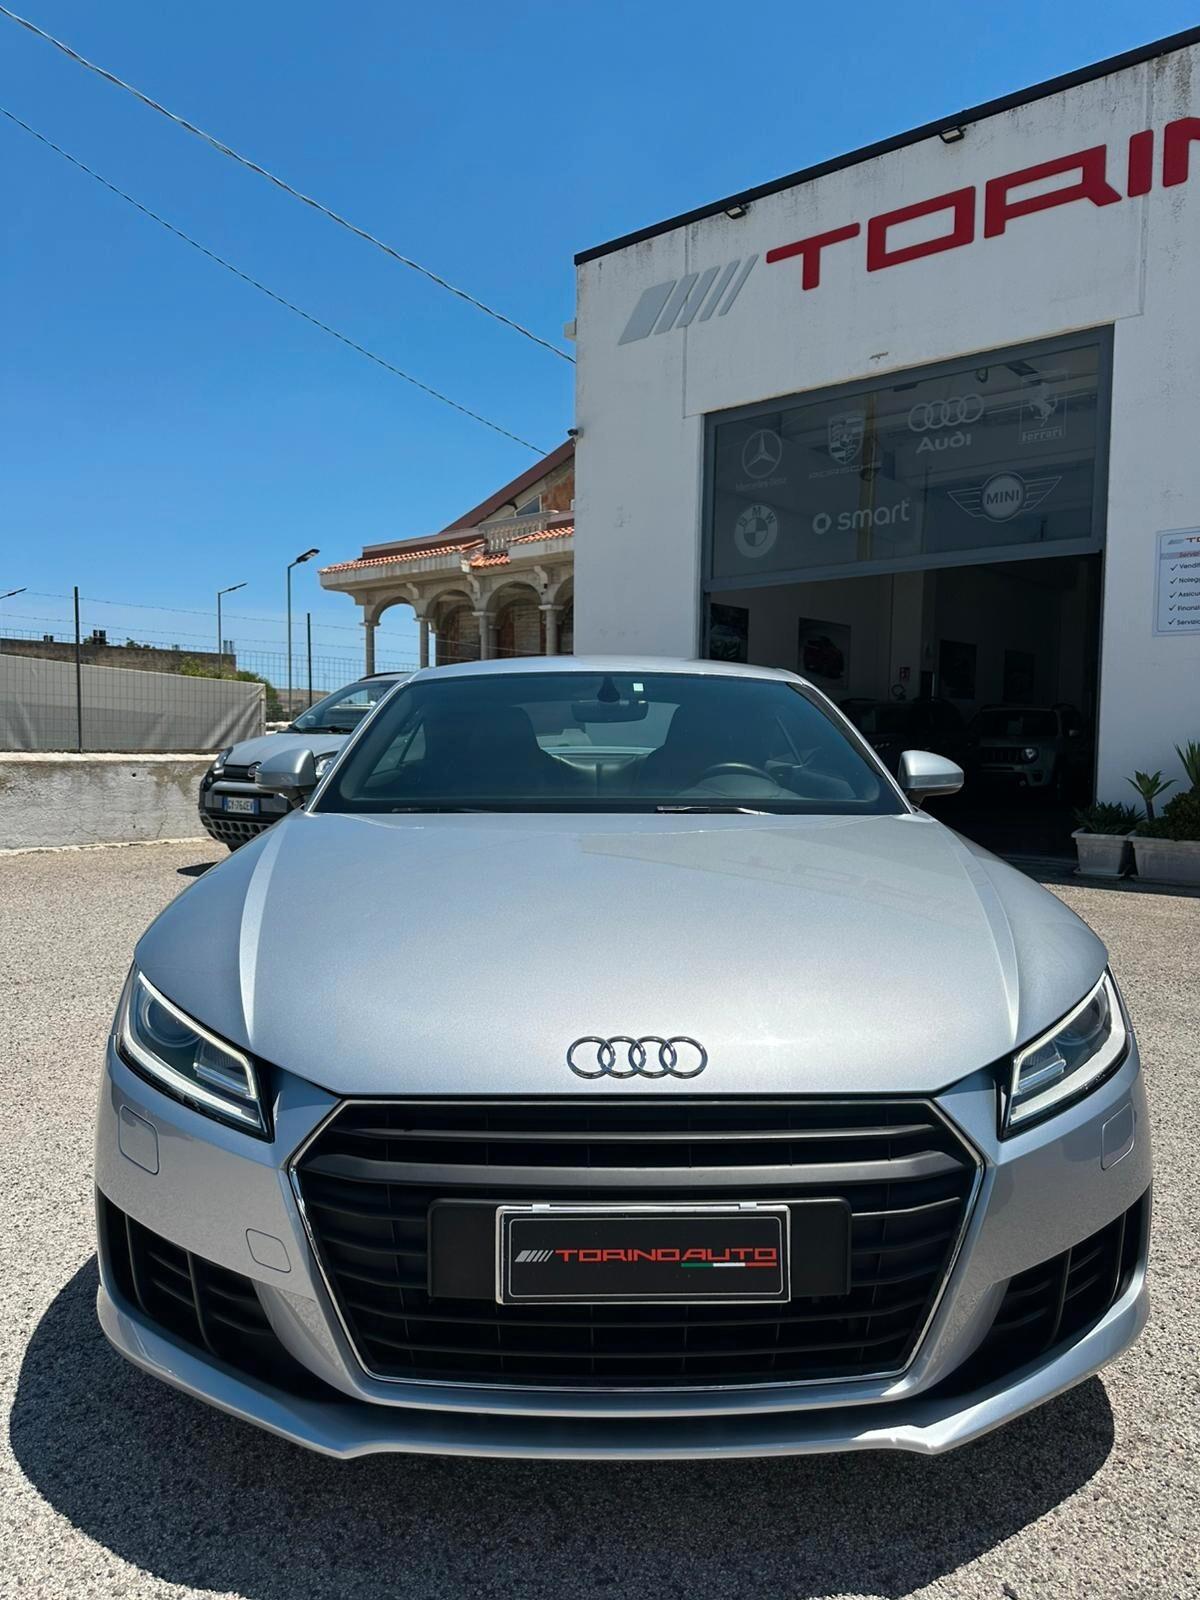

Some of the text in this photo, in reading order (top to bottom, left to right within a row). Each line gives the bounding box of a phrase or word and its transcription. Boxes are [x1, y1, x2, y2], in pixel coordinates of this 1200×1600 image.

[916, 431, 972, 454] Audi
[1021, 428, 1063, 443] Ferrari
[986, 489, 1020, 505] MINI
[837, 500, 910, 531] smart
